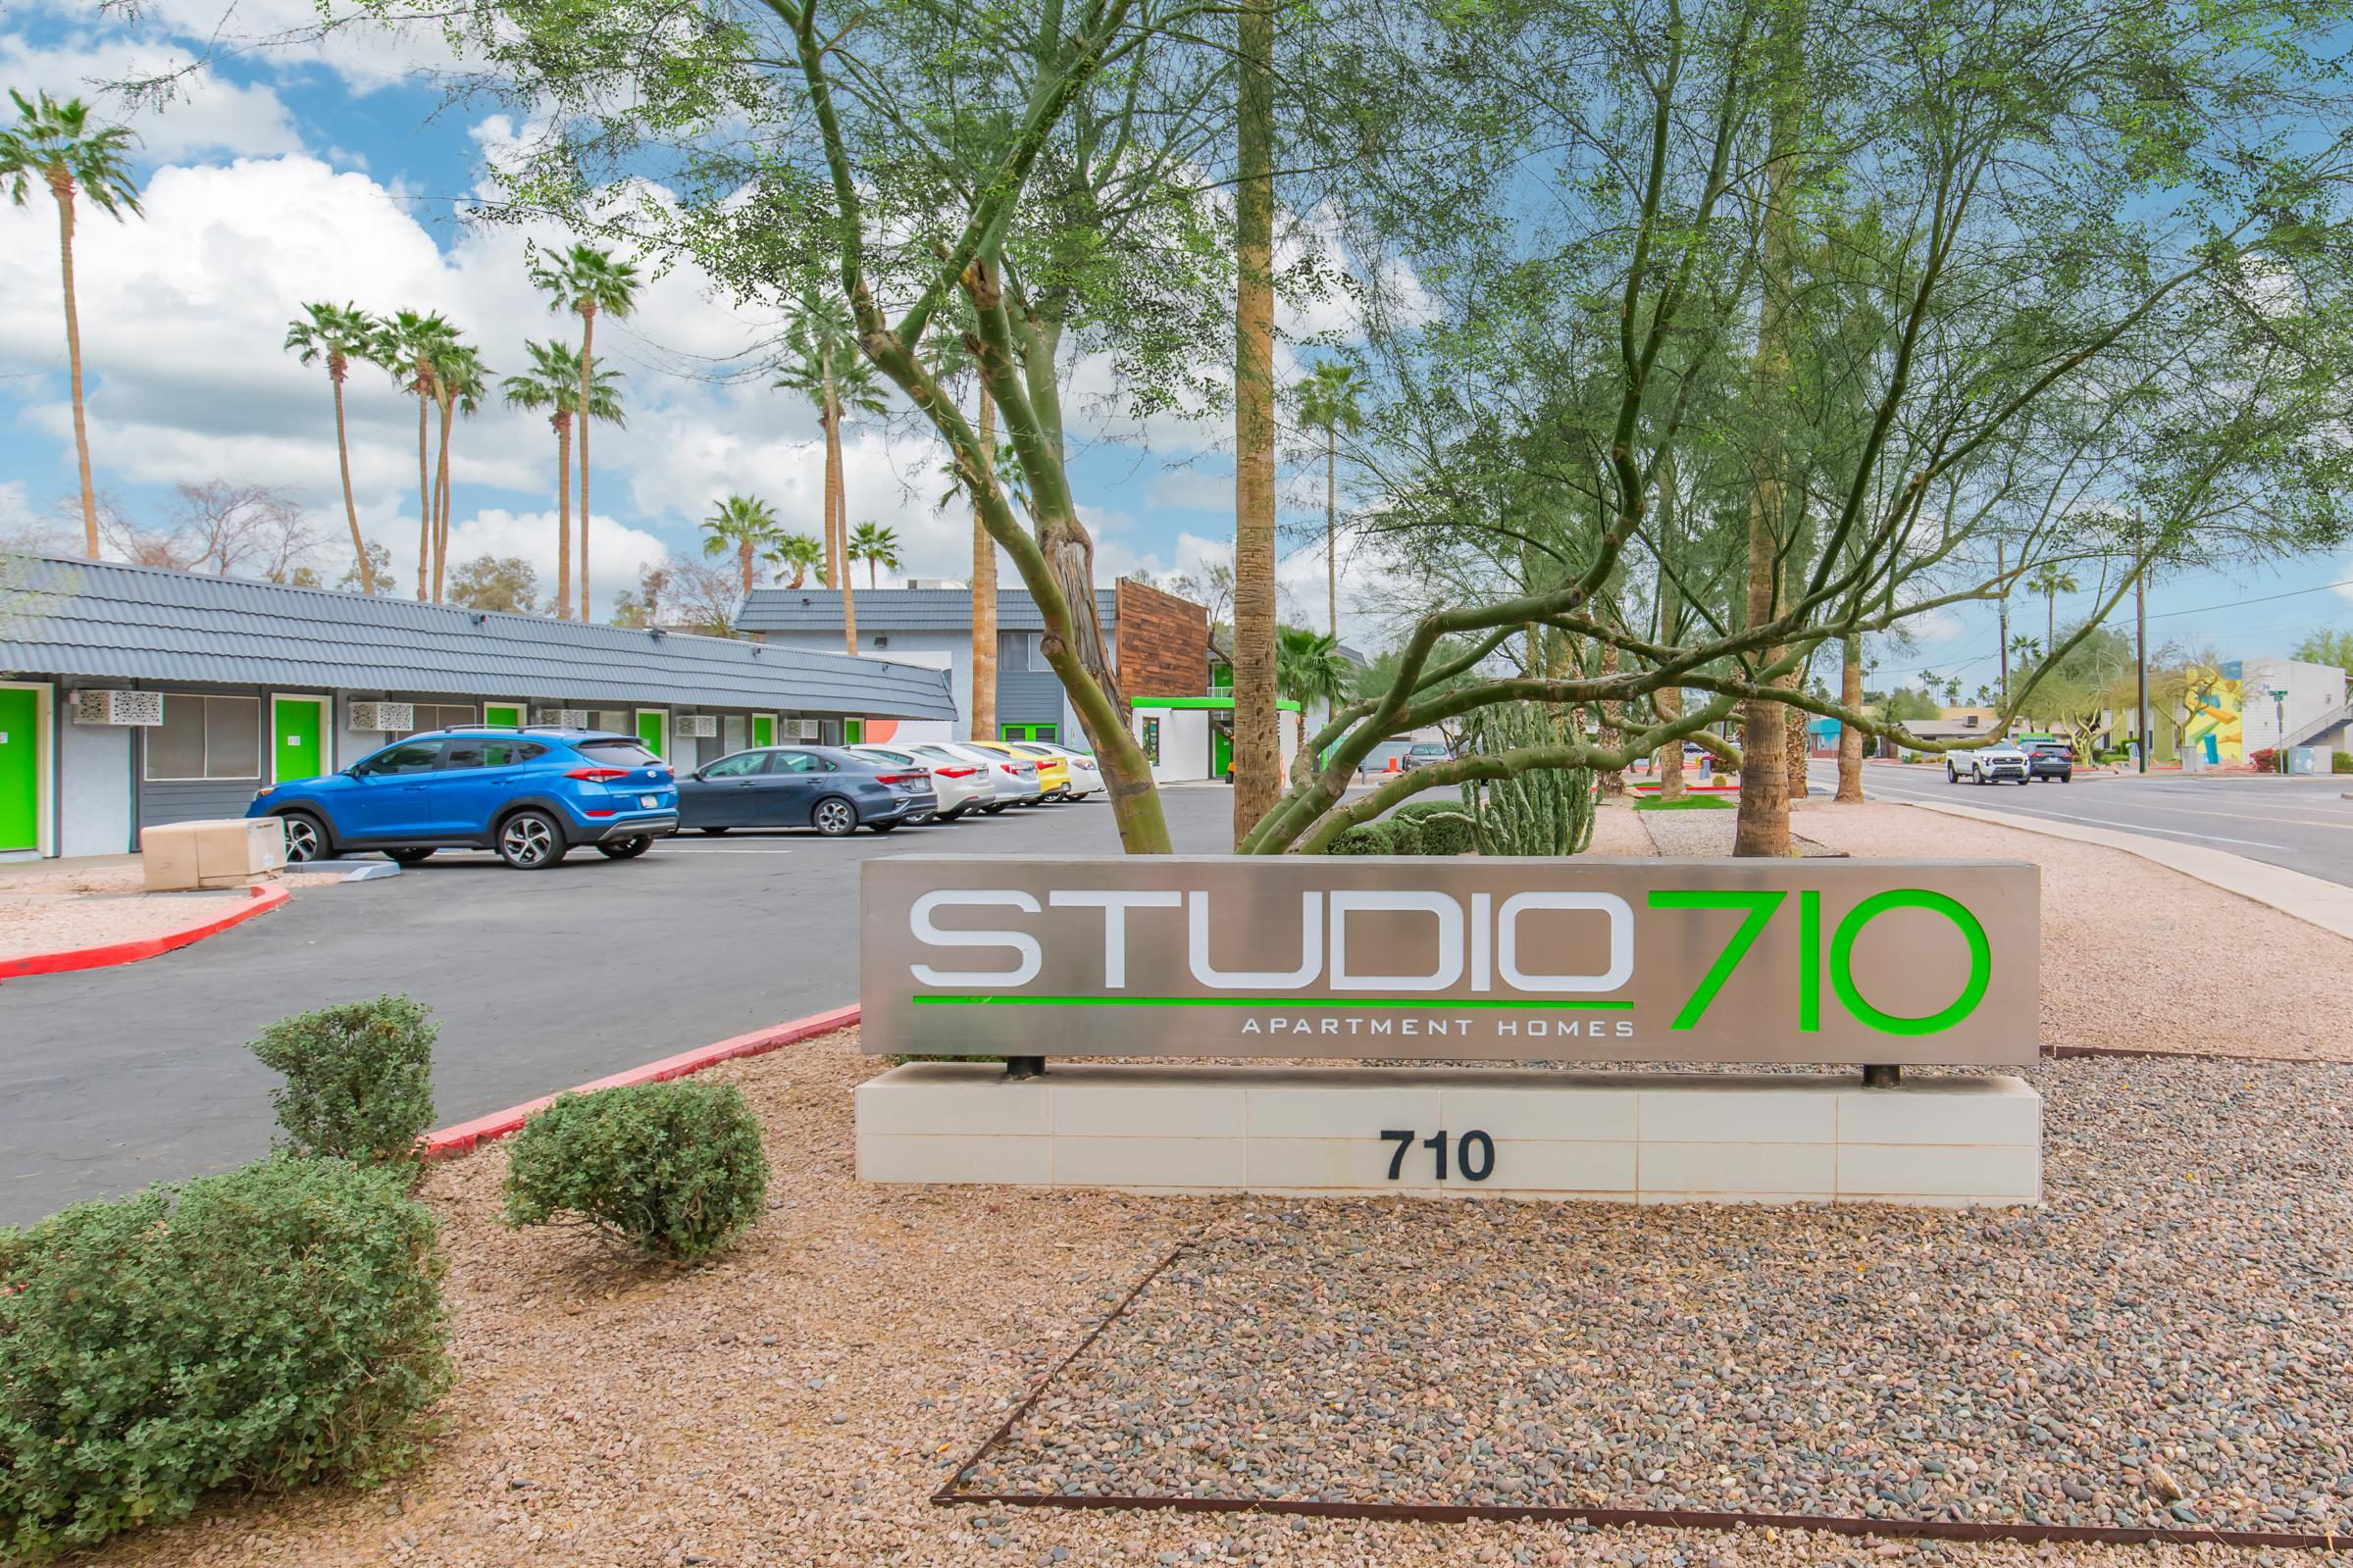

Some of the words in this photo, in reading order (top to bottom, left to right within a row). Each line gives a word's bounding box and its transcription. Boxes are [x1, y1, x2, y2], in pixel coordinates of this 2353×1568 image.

[909, 889, 1634, 992] STUDIO
[1648, 889, 1990, 1036] 710
[1241, 1018, 1473, 1036] APARTMENT
[1498, 1020, 1634, 1037] HOMES
[1380, 1130, 1495, 1182] 710
